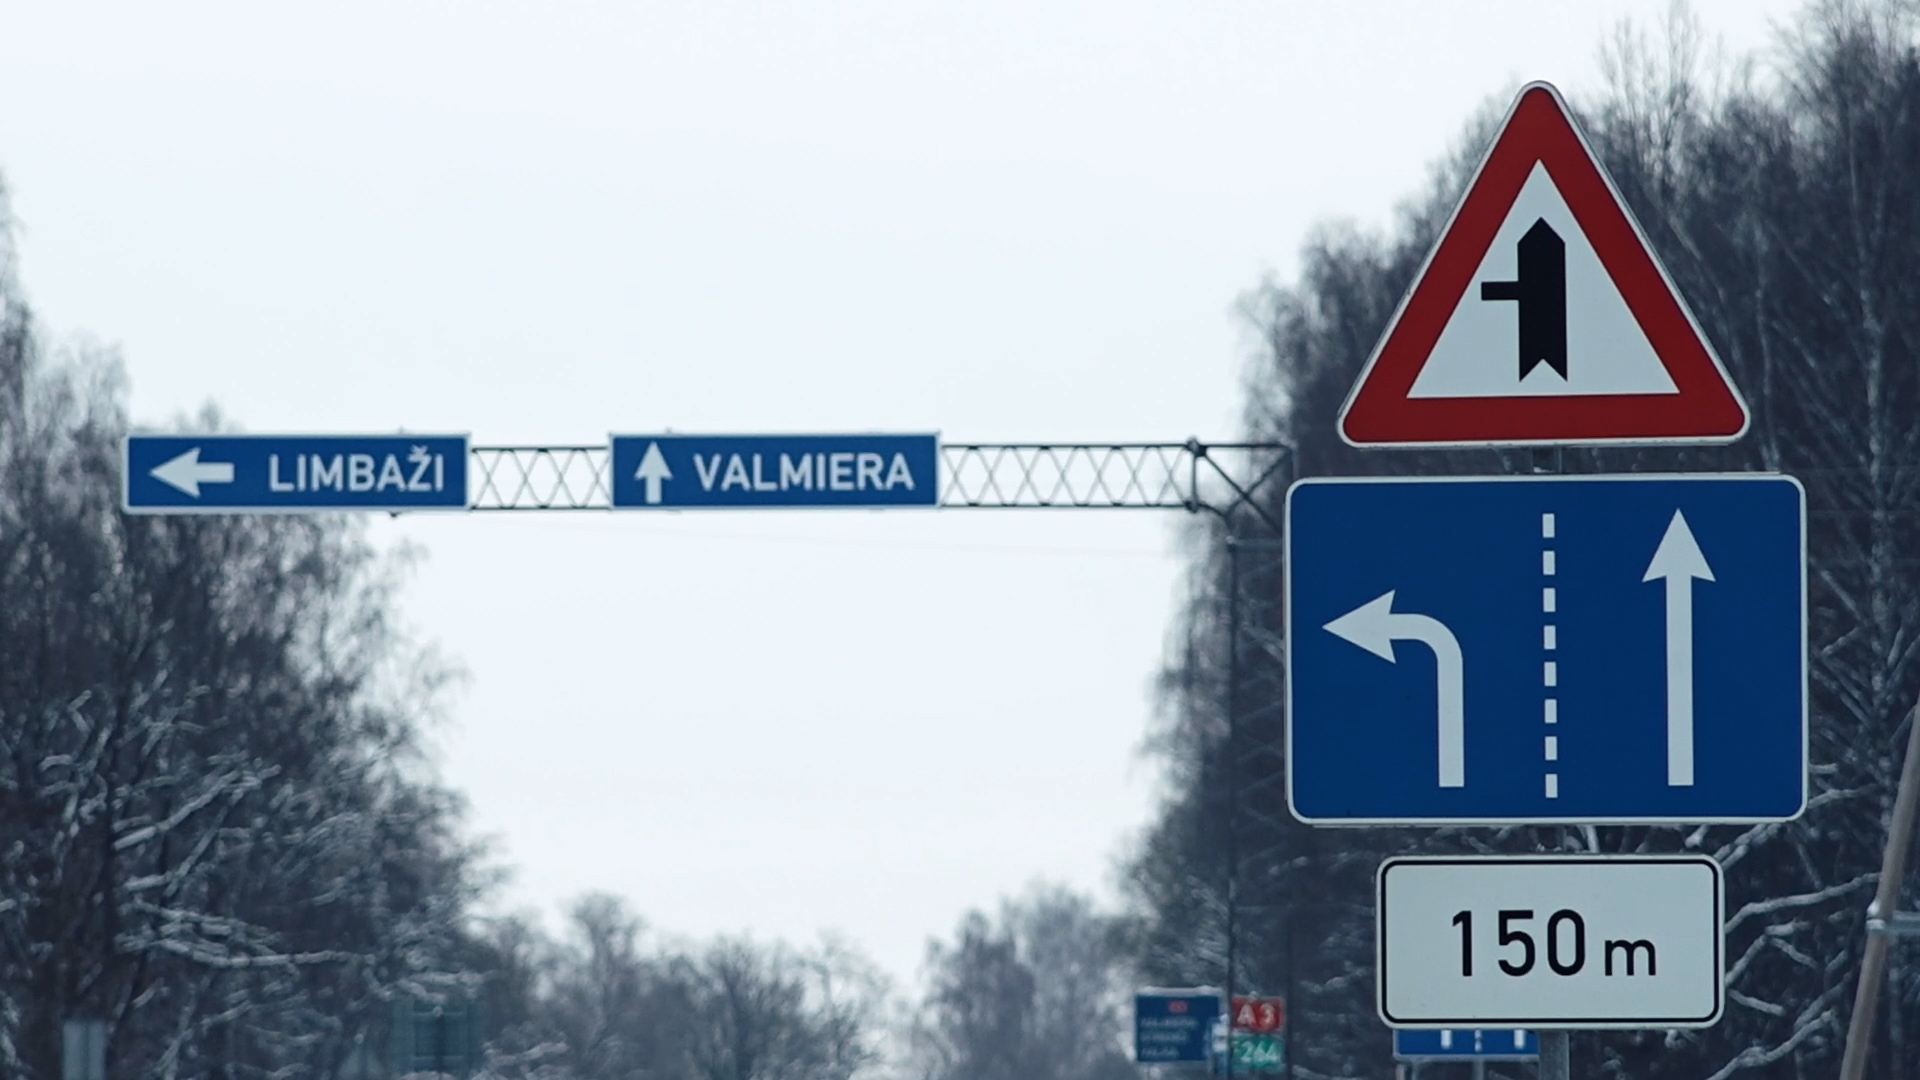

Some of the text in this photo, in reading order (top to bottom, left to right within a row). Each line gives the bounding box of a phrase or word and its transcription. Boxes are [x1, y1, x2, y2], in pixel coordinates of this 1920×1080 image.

[269, 445, 444, 492] LIMBAŽI
[693, 452, 915, 492] VALMIERA
[1452, 909, 1656, 977] 150 m
